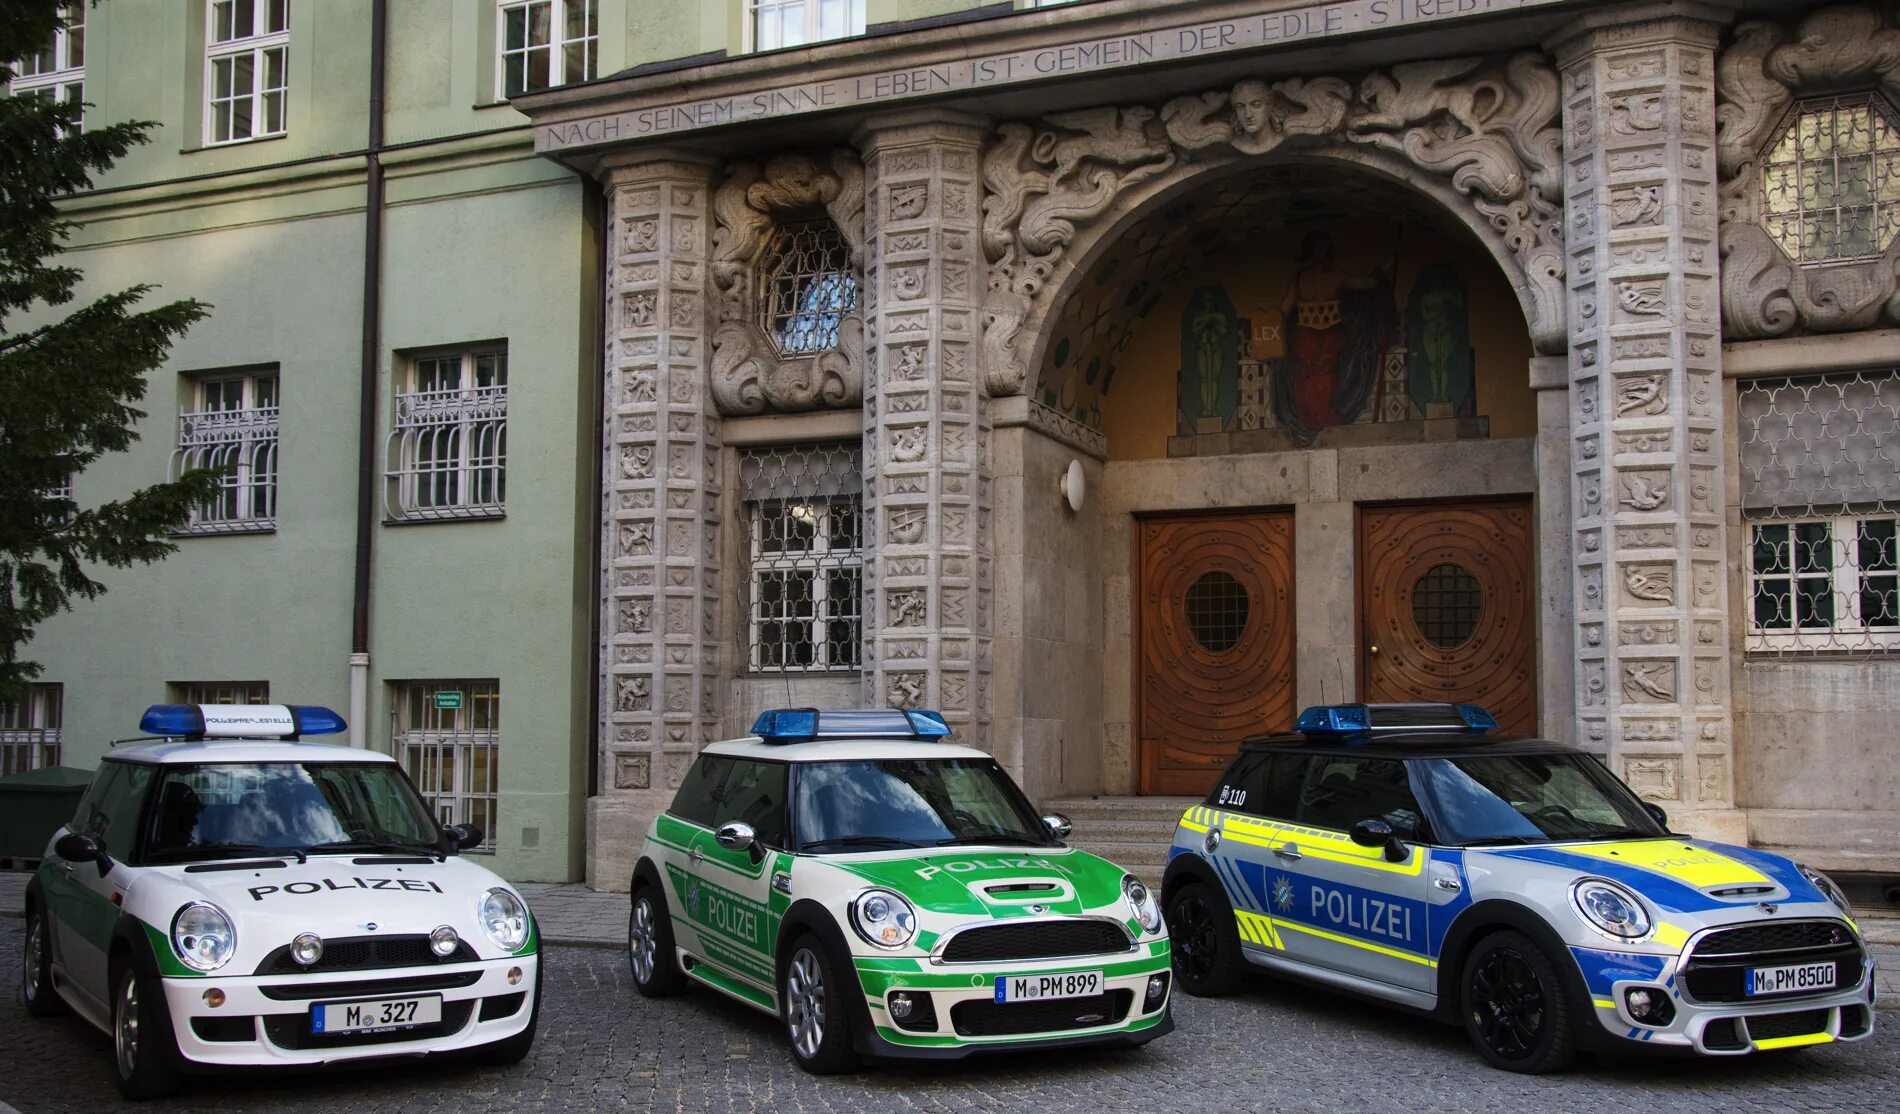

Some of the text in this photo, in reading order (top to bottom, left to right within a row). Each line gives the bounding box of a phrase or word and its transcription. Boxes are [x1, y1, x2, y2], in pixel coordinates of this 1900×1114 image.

[547, 117, 619, 147] NACH
[637, 99, 733, 133] SEINEM
[752, 83, 836, 116] SINNE
[855, 66, 951, 101] LEBEN
[971, 55, 1020, 84] IST
[1033, 35, 1154, 73] GEMEIN
[1178, 23, 1237, 54] DER
[1262, 7, 1343, 41] EDLE
[1253, 325, 1281, 342] LEX
[1227, 788, 1247, 807] 110
[914, 858, 1075, 881] POLIZEI
[1653, 856, 1730, 869] POLIZ
[247, 876, 444, 902] POLIZEI
[708, 895, 758, 944] POLIZEI
[1311, 885, 1411, 941] POLIZEI
[1015, 978, 1027, 998] M
[1040, 976, 1063, 997] PM
[1066, 973, 1097, 995] 899
[1755, 971, 1765, 991] M
[1775, 968, 1795, 989] PM
[1798, 965, 1834, 987] 8500
[346, 1005, 361, 1027] M
[380, 1000, 419, 1024] 327
